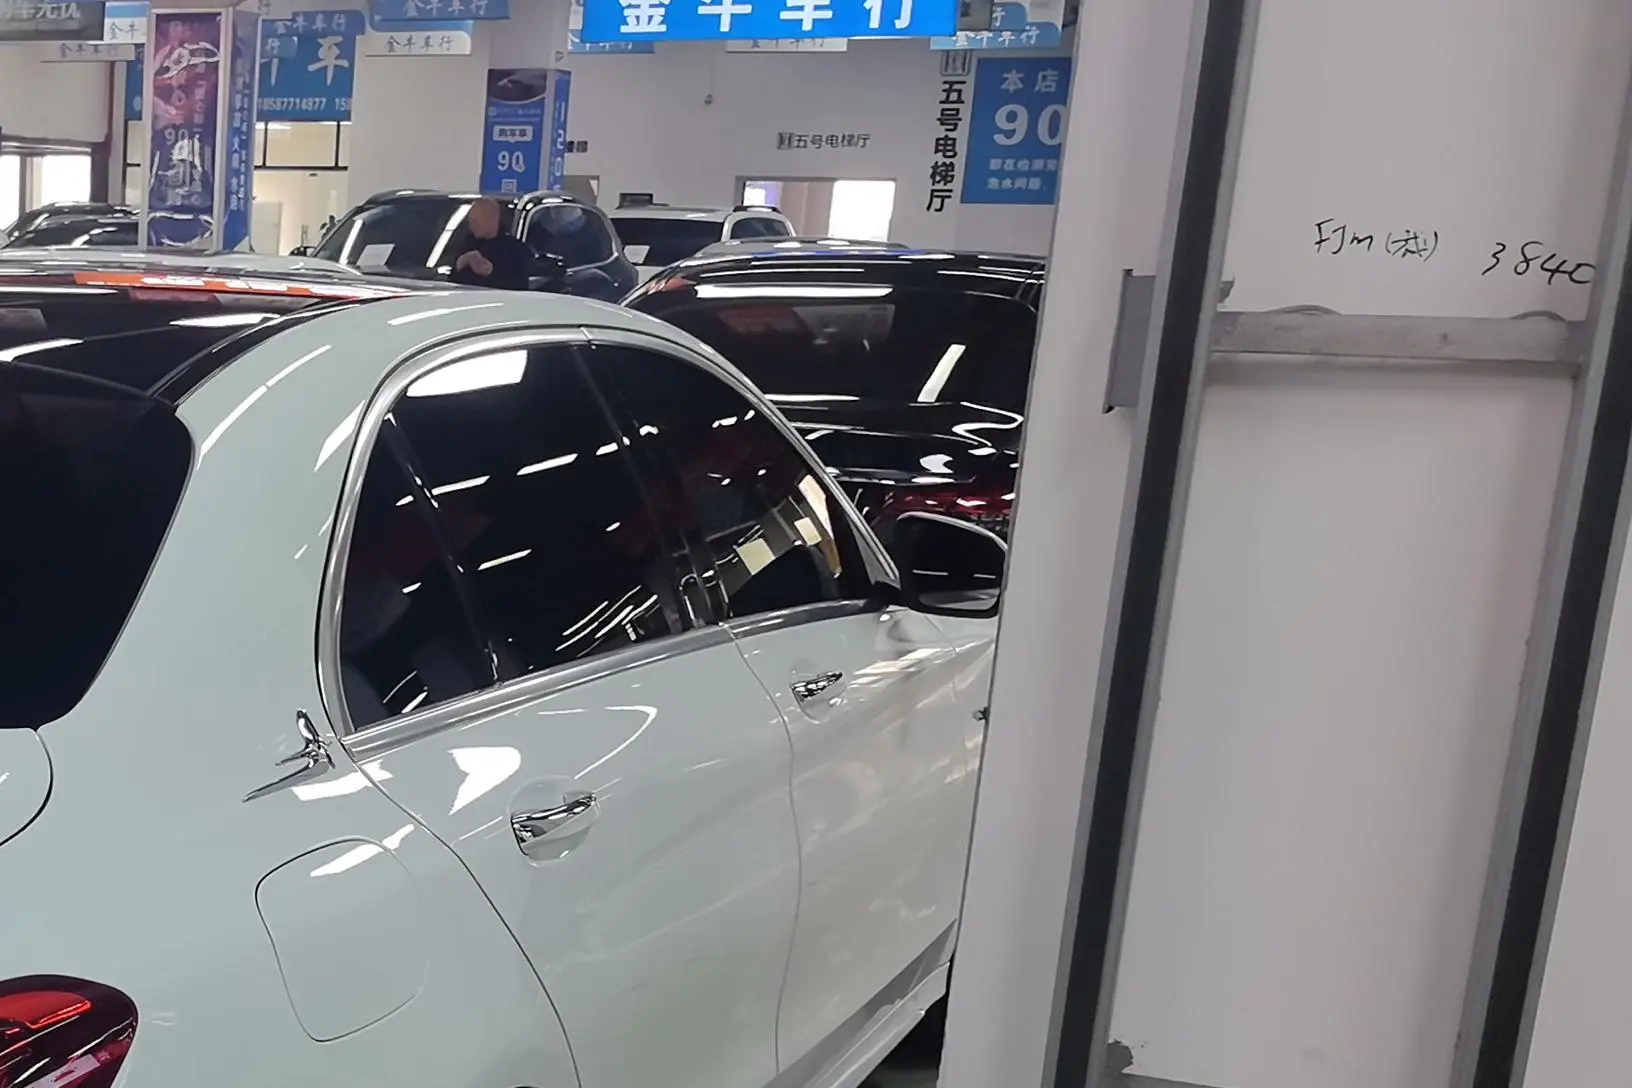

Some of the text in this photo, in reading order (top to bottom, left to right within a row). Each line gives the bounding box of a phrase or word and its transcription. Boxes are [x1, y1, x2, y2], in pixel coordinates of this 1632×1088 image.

[385, 34, 455, 53] 金牛车行
[793, 133, 871, 150] 五号电梯厅
[925, 80, 967, 213] 五号电梯厅
